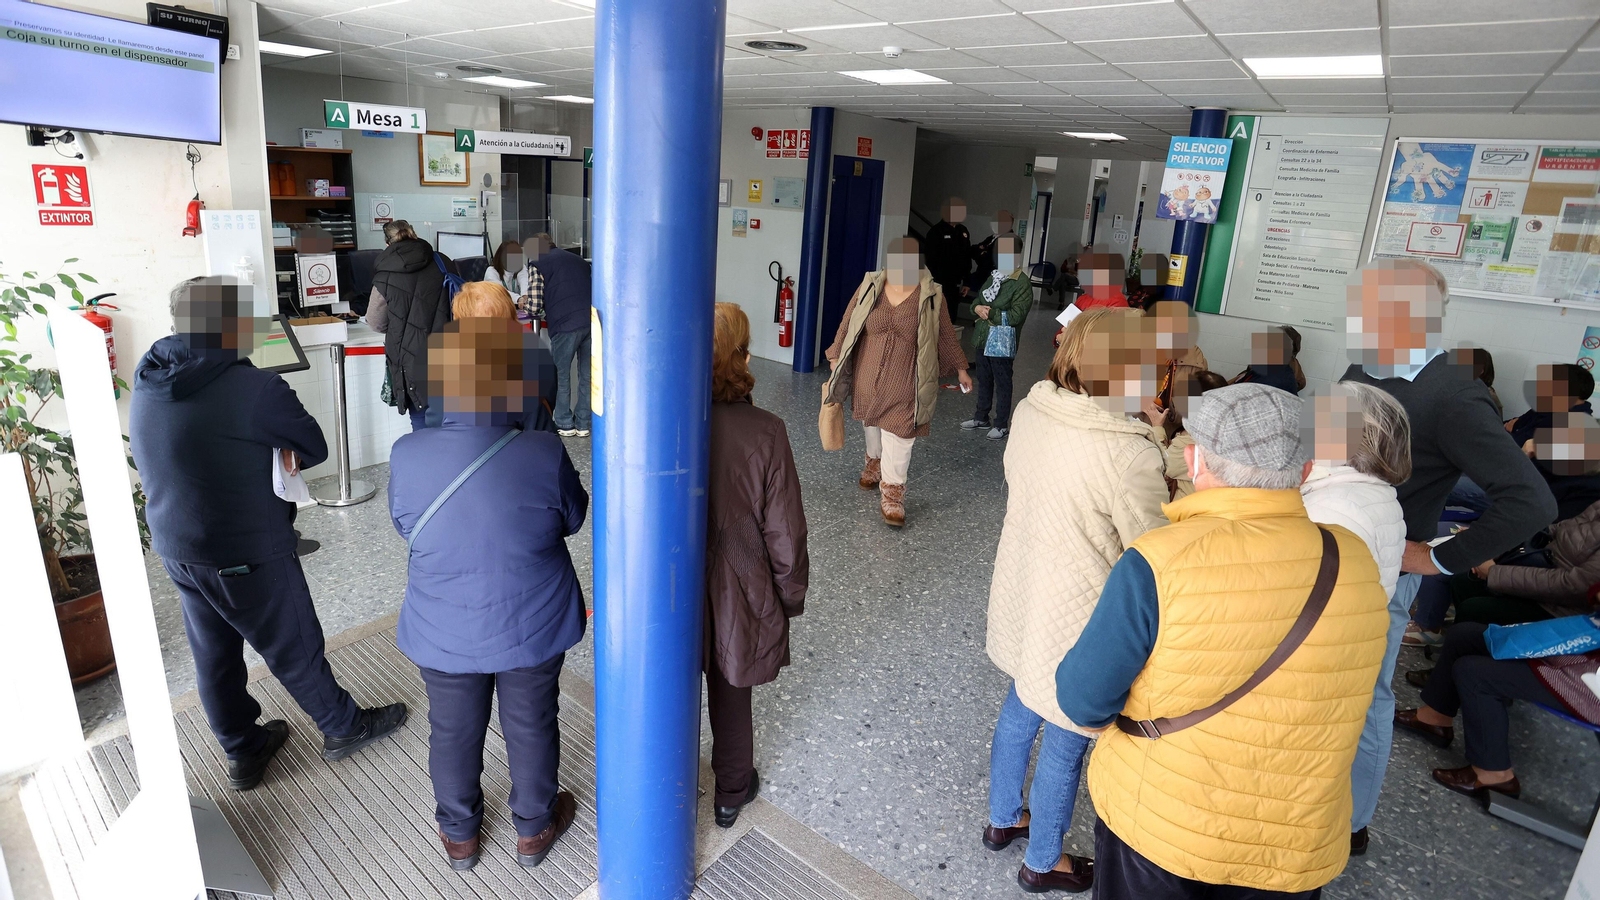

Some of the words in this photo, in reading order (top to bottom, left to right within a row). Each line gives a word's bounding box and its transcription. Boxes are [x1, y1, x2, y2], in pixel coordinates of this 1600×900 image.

[160, 12, 173, 20] SU
[177, 15, 208, 26] TURNO
[14, 20, 62, 34] Preservamos
[118, 39, 154, 50] llamaremos
[155, 46, 173, 54] desde
[6, 29, 36, 43] Coja
[40, 36, 55, 45] su
[59, 39, 90, 51] turno
[93, 46, 107, 55] en
[111, 48, 121, 57] el
[124, 50, 188, 67] dispensador
[330, 108, 346, 123] A
[356, 109, 402, 127] Mesa
[410, 113, 421, 129] 1
[1229, 121, 1248, 139] A
[459, 134, 472, 147] A
[479, 139, 508, 147] Atención
[520, 141, 554, 149] Ciudadanía
[1173, 142, 1227, 155] SILENCIO
[1265, 141, 1271, 150] 1
[1170, 154, 1190, 164] POR
[1191, 156, 1225, 166] FAVOR
[1255, 192, 1262, 202] 0
[41, 212, 91, 224] EXTINTOR
